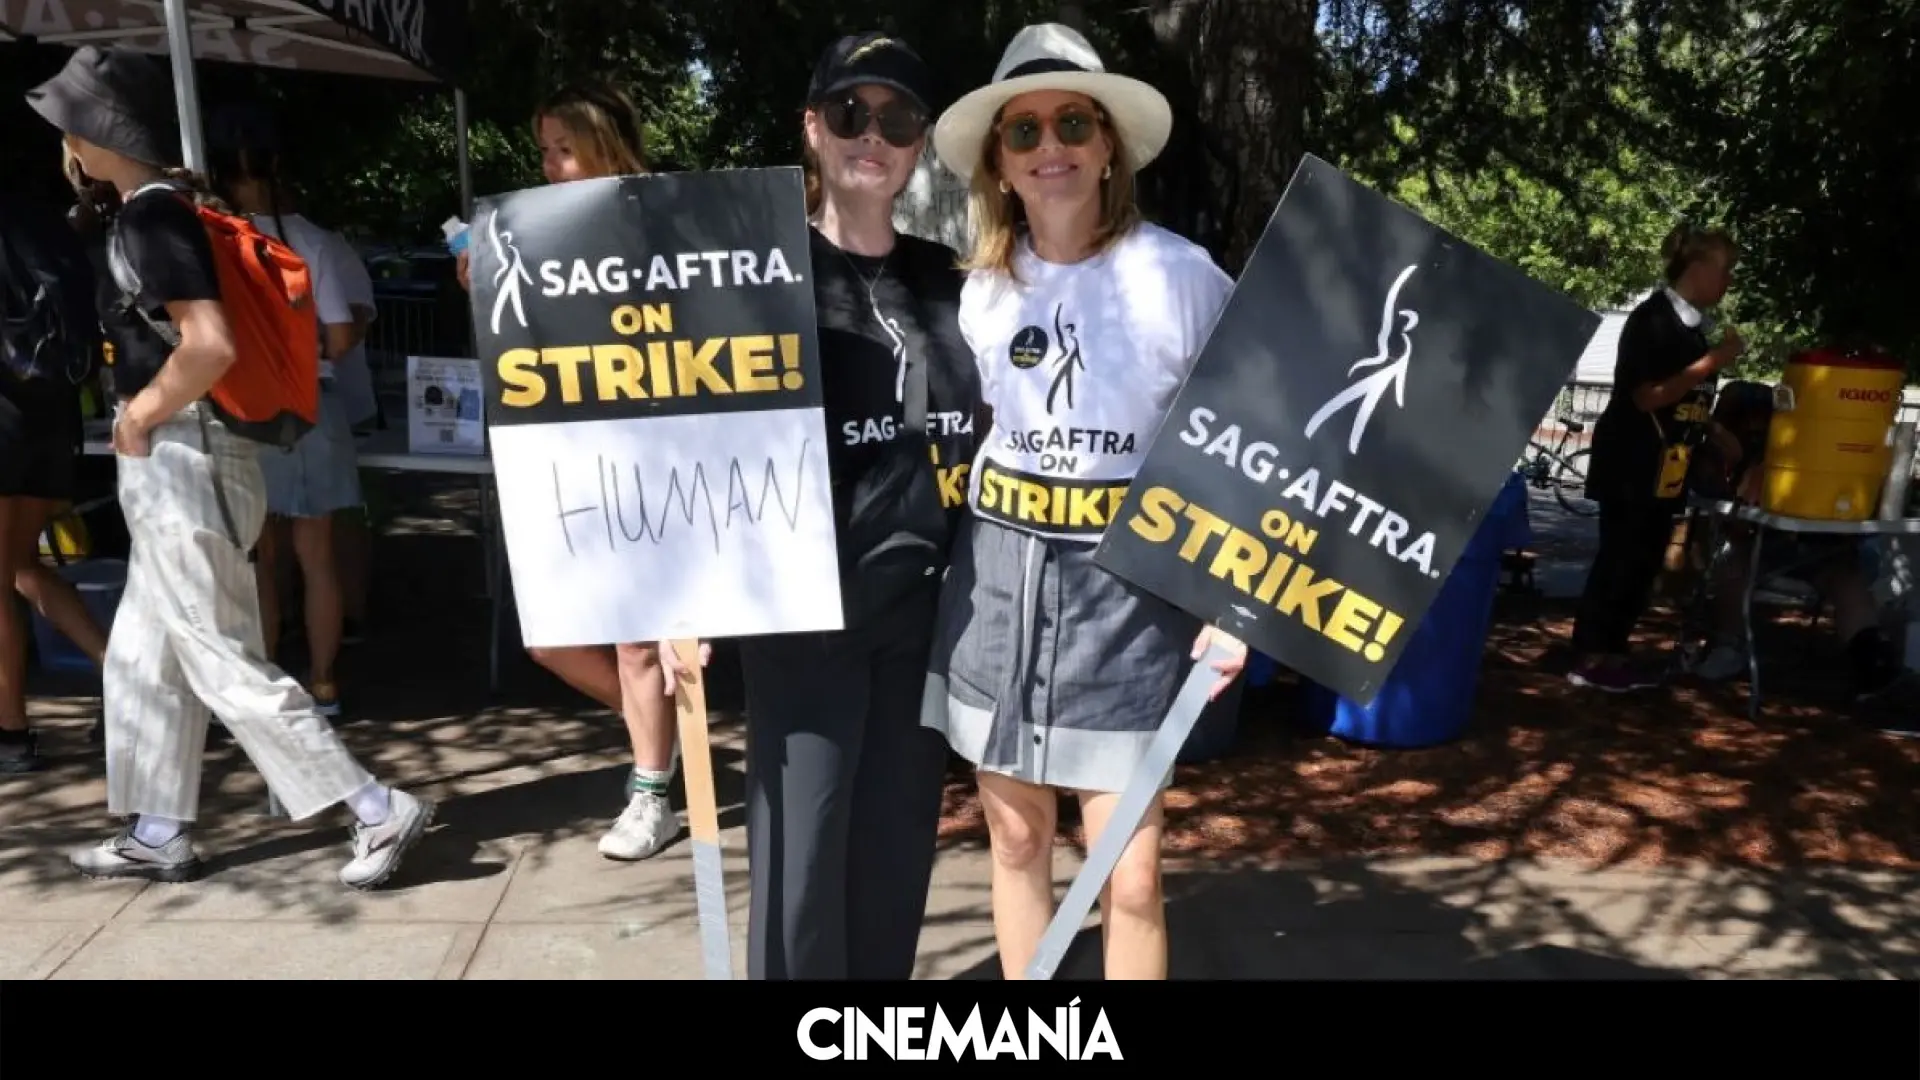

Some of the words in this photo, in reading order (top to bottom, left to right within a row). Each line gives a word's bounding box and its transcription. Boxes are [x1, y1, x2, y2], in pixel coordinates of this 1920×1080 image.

[611, 303, 673, 335] ON
[497, 333, 804, 408] STRIKE!
[1040, 454, 1078, 473] ON
[552, 438, 810, 558] HUMAN
[1260, 509, 1319, 554] ON
[1128, 486, 1405, 662] STRIKE!
